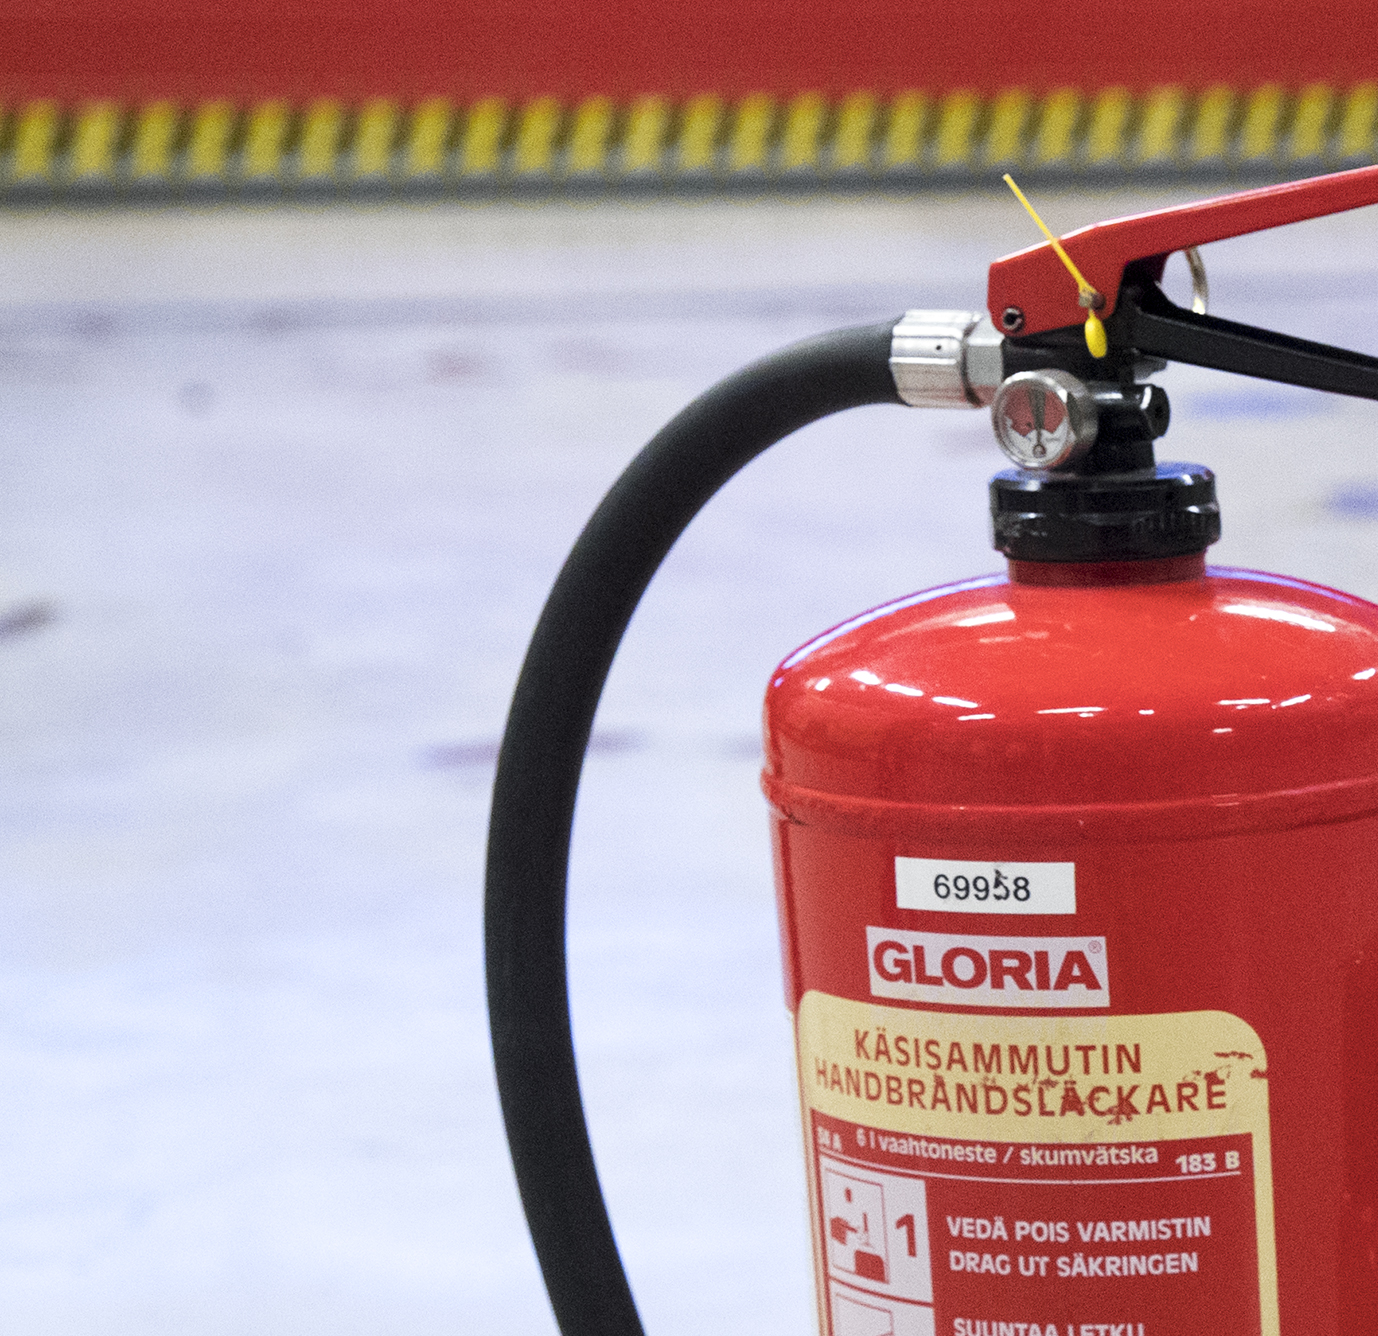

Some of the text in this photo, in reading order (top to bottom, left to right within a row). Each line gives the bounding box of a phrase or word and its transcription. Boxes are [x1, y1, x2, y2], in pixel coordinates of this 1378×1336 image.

[933, 874, 1031, 901] 69958
[873, 940, 1102, 992] GLORIA
[854, 1028, 1142, 1076] KÄSISAMMUTIN
[856, 1128, 866, 1148] 6
[878, 1134, 997, 1166] vaahtoneste
[1020, 1143, 1158, 1167] skumvätska
[1175, 1153, 1217, 1174] 183
[1225, 1150, 1240, 1170] B
[895, 1213, 917, 1258] 1
[947, 1216, 1211, 1243] VEDÄ POIS VARMISTIN
[950, 1250, 1199, 1277] DRAG UT SÄKRINGEN
